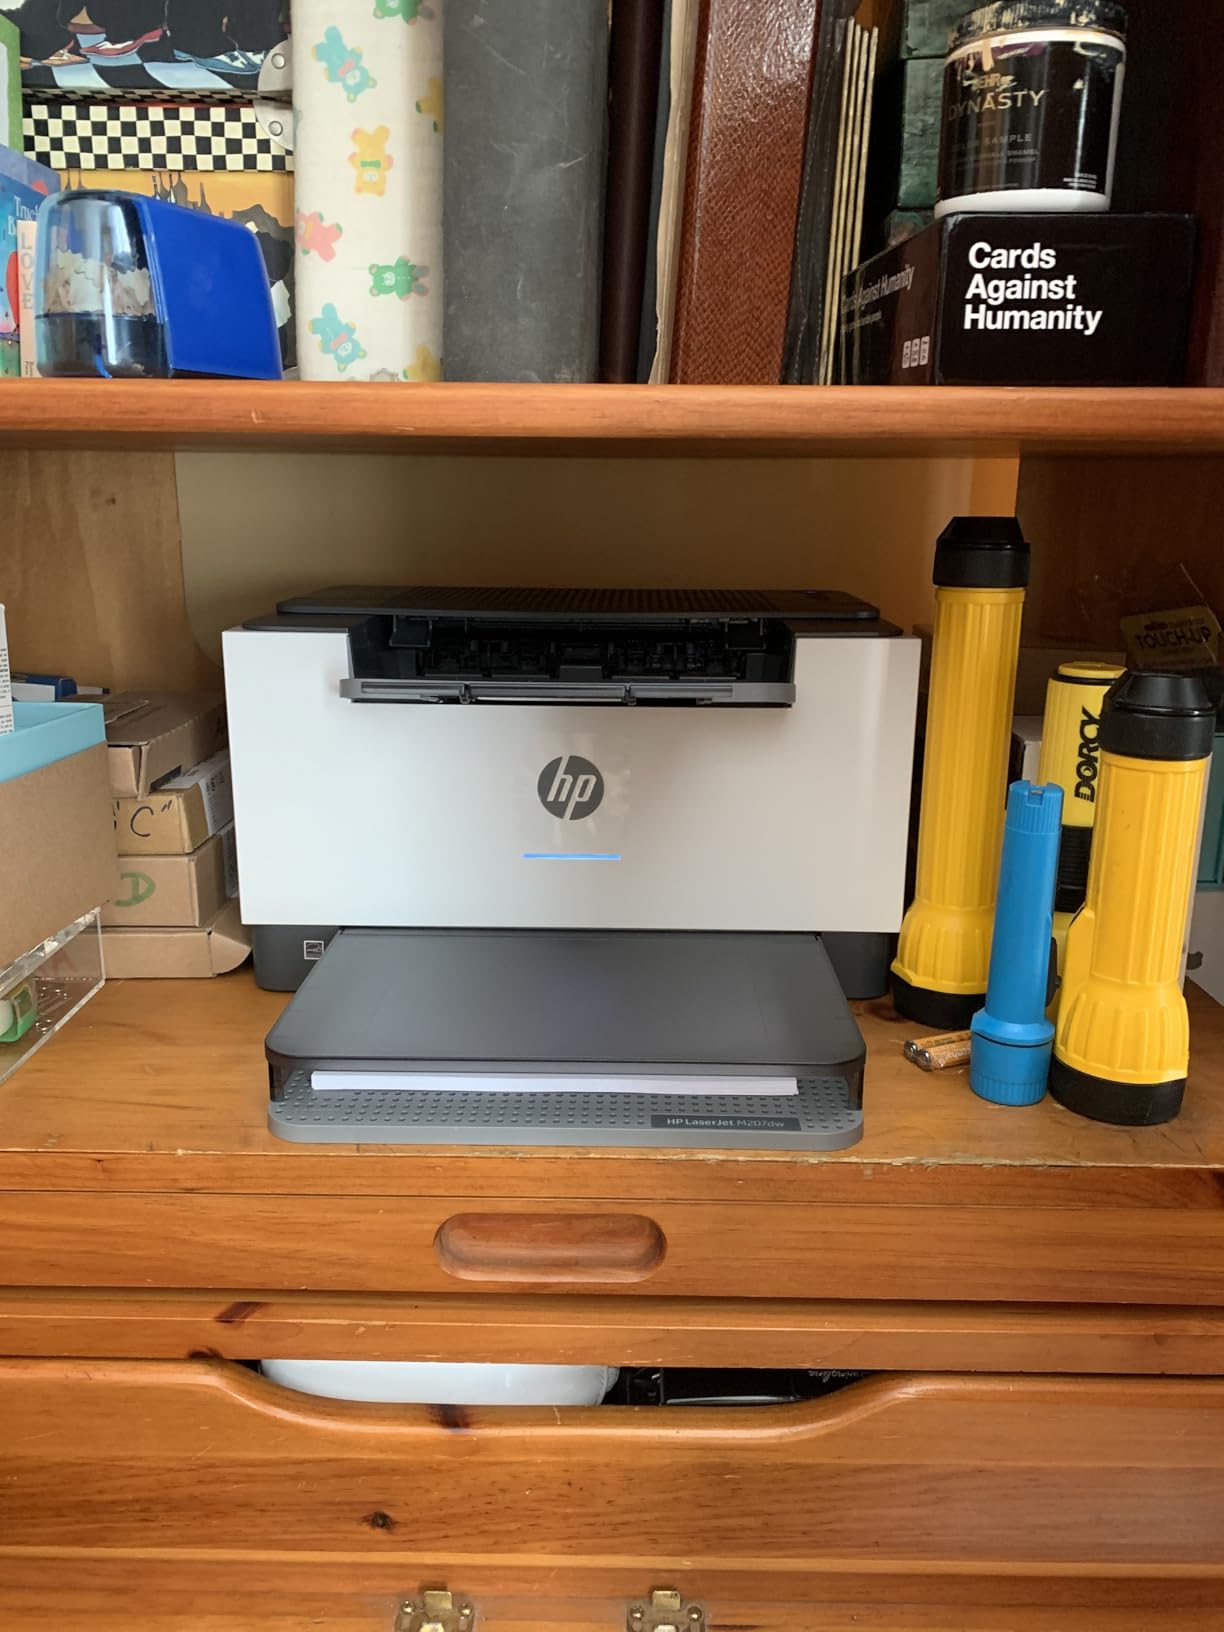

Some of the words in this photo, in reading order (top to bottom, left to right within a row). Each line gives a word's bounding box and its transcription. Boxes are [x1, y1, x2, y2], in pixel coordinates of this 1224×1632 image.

[948, 89, 1047, 121] DYNASTY
[21, 231, 33, 310] LOVE
[968, 241, 1057, 270] Cards
[881, 264, 915, 297] Humanity
[964, 273, 1078, 306] Against
[963, 303, 1104, 336] Humanity
[1134, 626, 1212, 649] TOUCH-UP
[1073, 704, 1102, 803] DORCY
[666, 1117, 684, 1126] HP
[685, 1118, 735, 1127] LaserJet
[736, 1119, 786, 1128] M207dw
